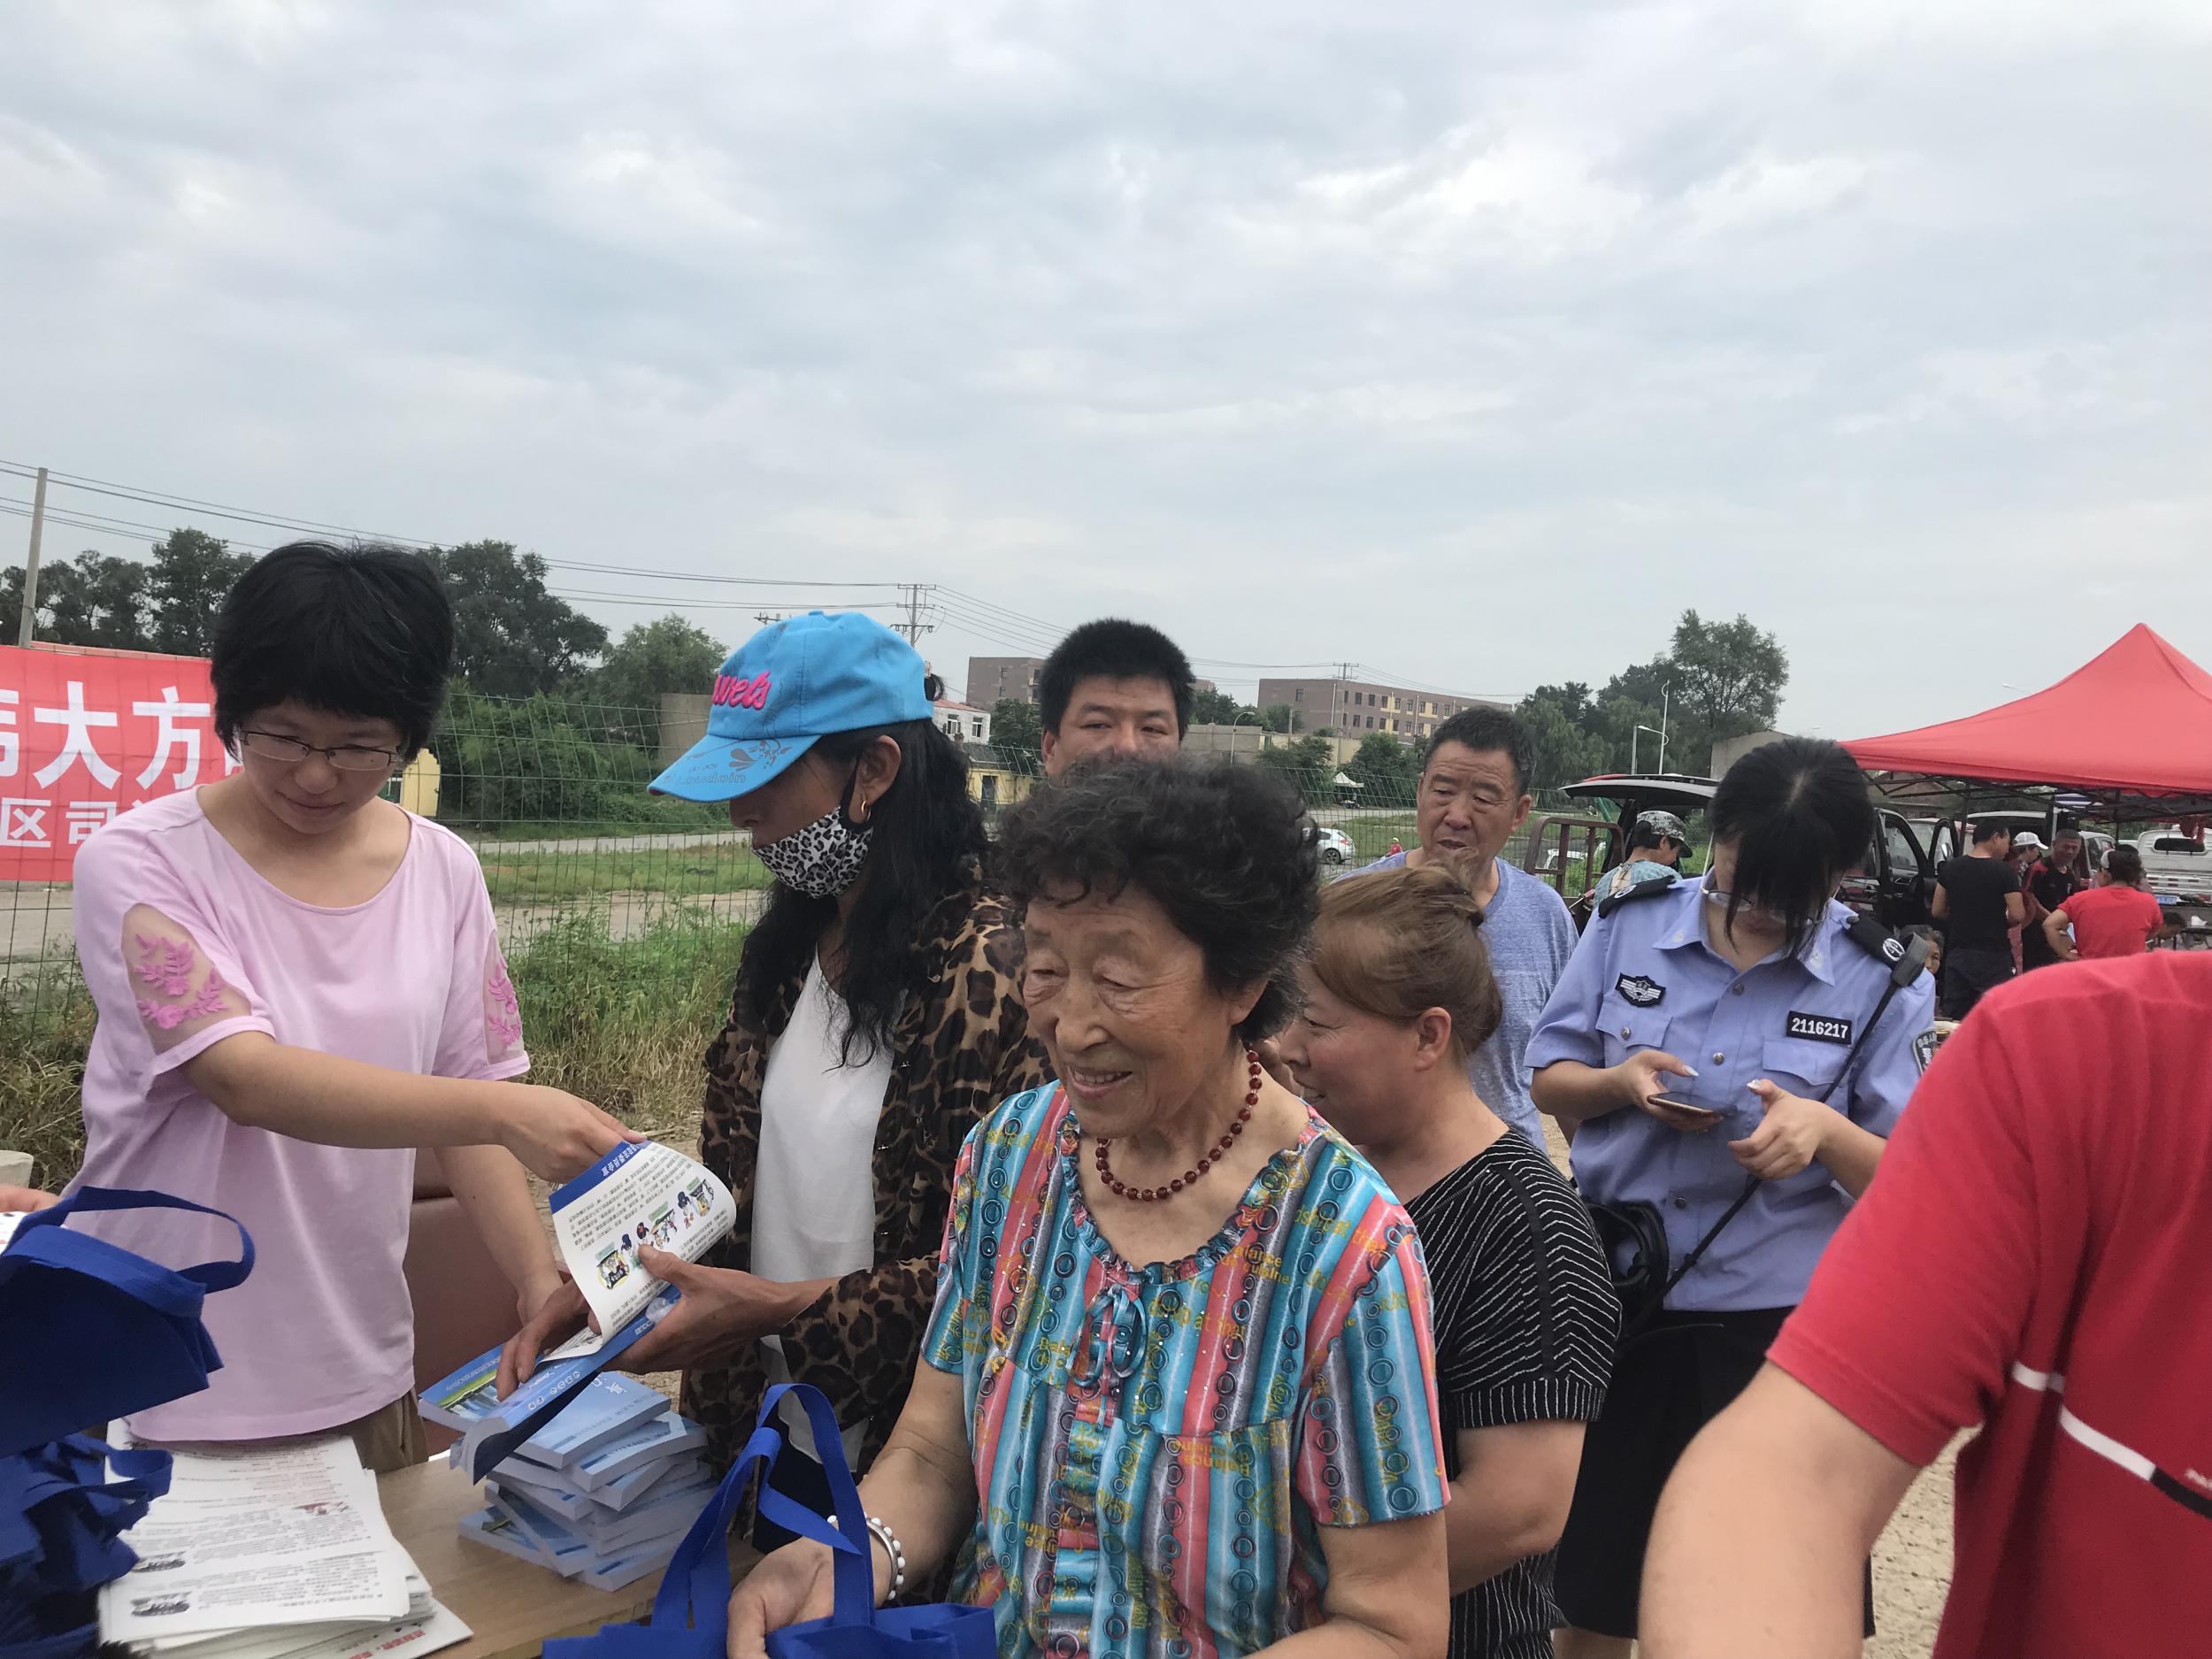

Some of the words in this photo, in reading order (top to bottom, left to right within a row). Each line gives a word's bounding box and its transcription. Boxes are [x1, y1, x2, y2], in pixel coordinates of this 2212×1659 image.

[0, 680, 243, 790] 大方
[0, 797, 145, 848] 区司
[1791, 1018, 1848, 1039] 2116217
